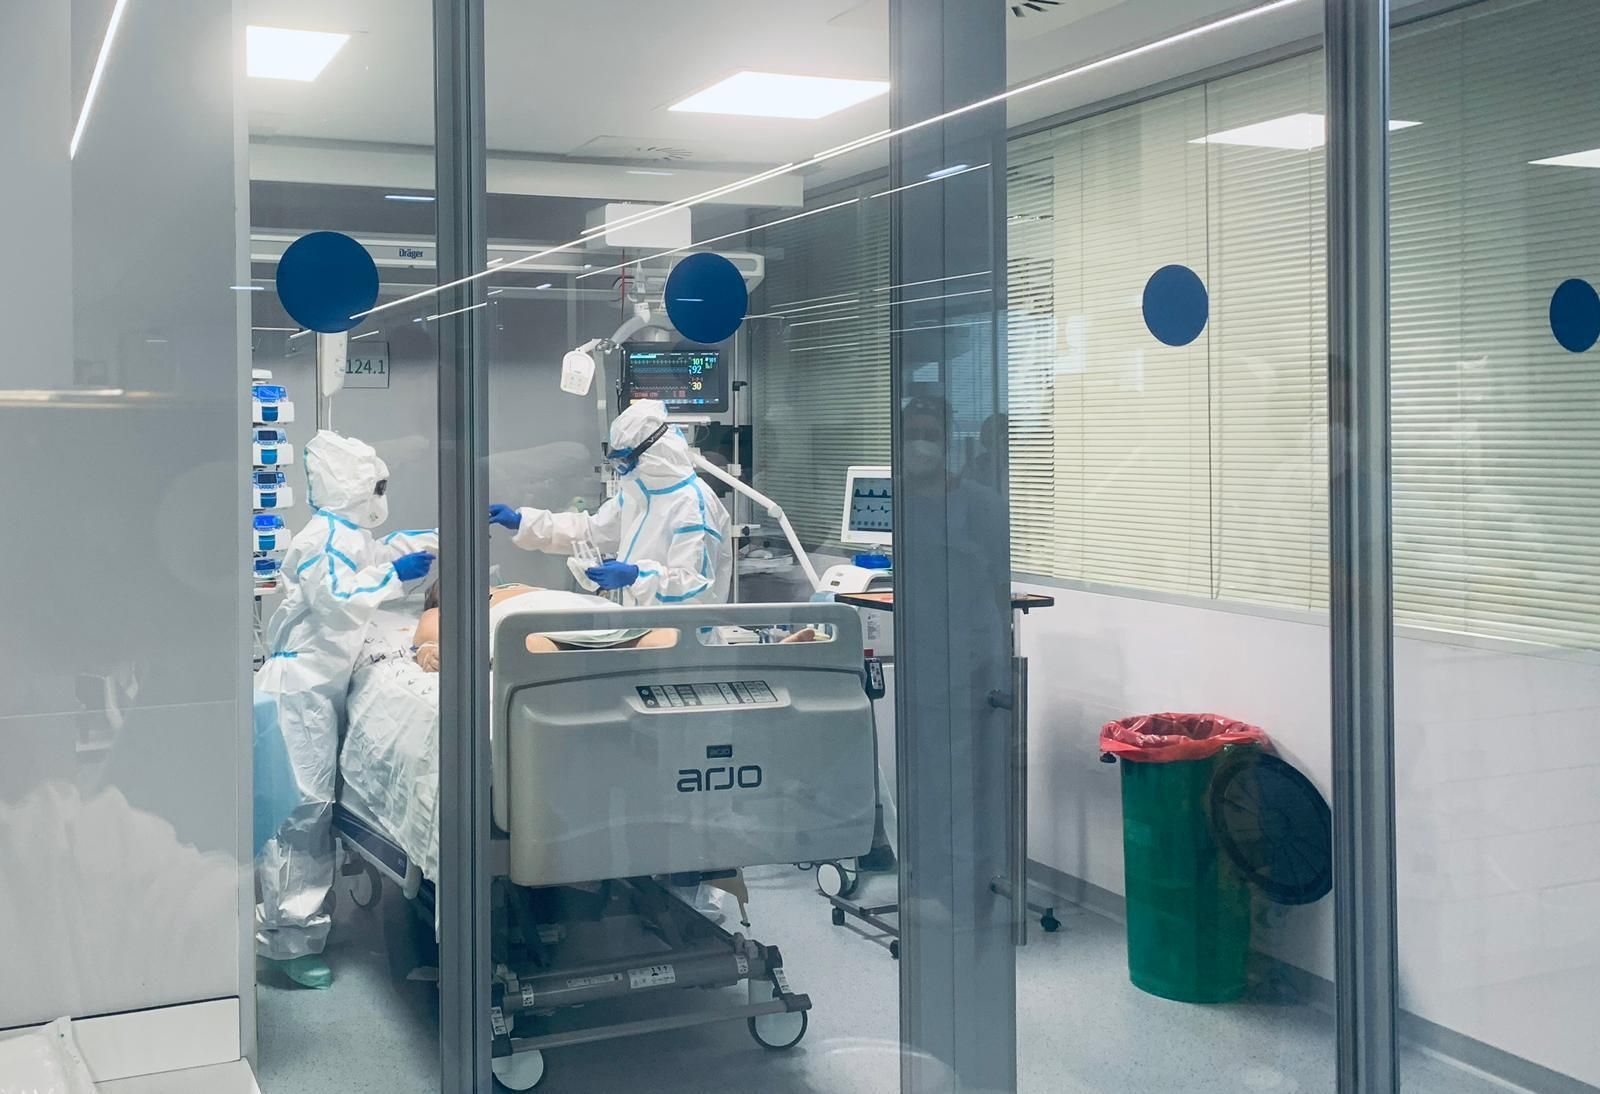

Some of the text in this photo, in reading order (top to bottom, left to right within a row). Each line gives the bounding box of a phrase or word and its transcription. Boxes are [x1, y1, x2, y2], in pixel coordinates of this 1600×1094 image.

[399, 248, 423, 259] Dräger
[346, 359, 385, 374] 124.1
[692, 365, 702, 374] 92
[691, 382, 702, 390] 30
[677, 765, 762, 792] arjo
